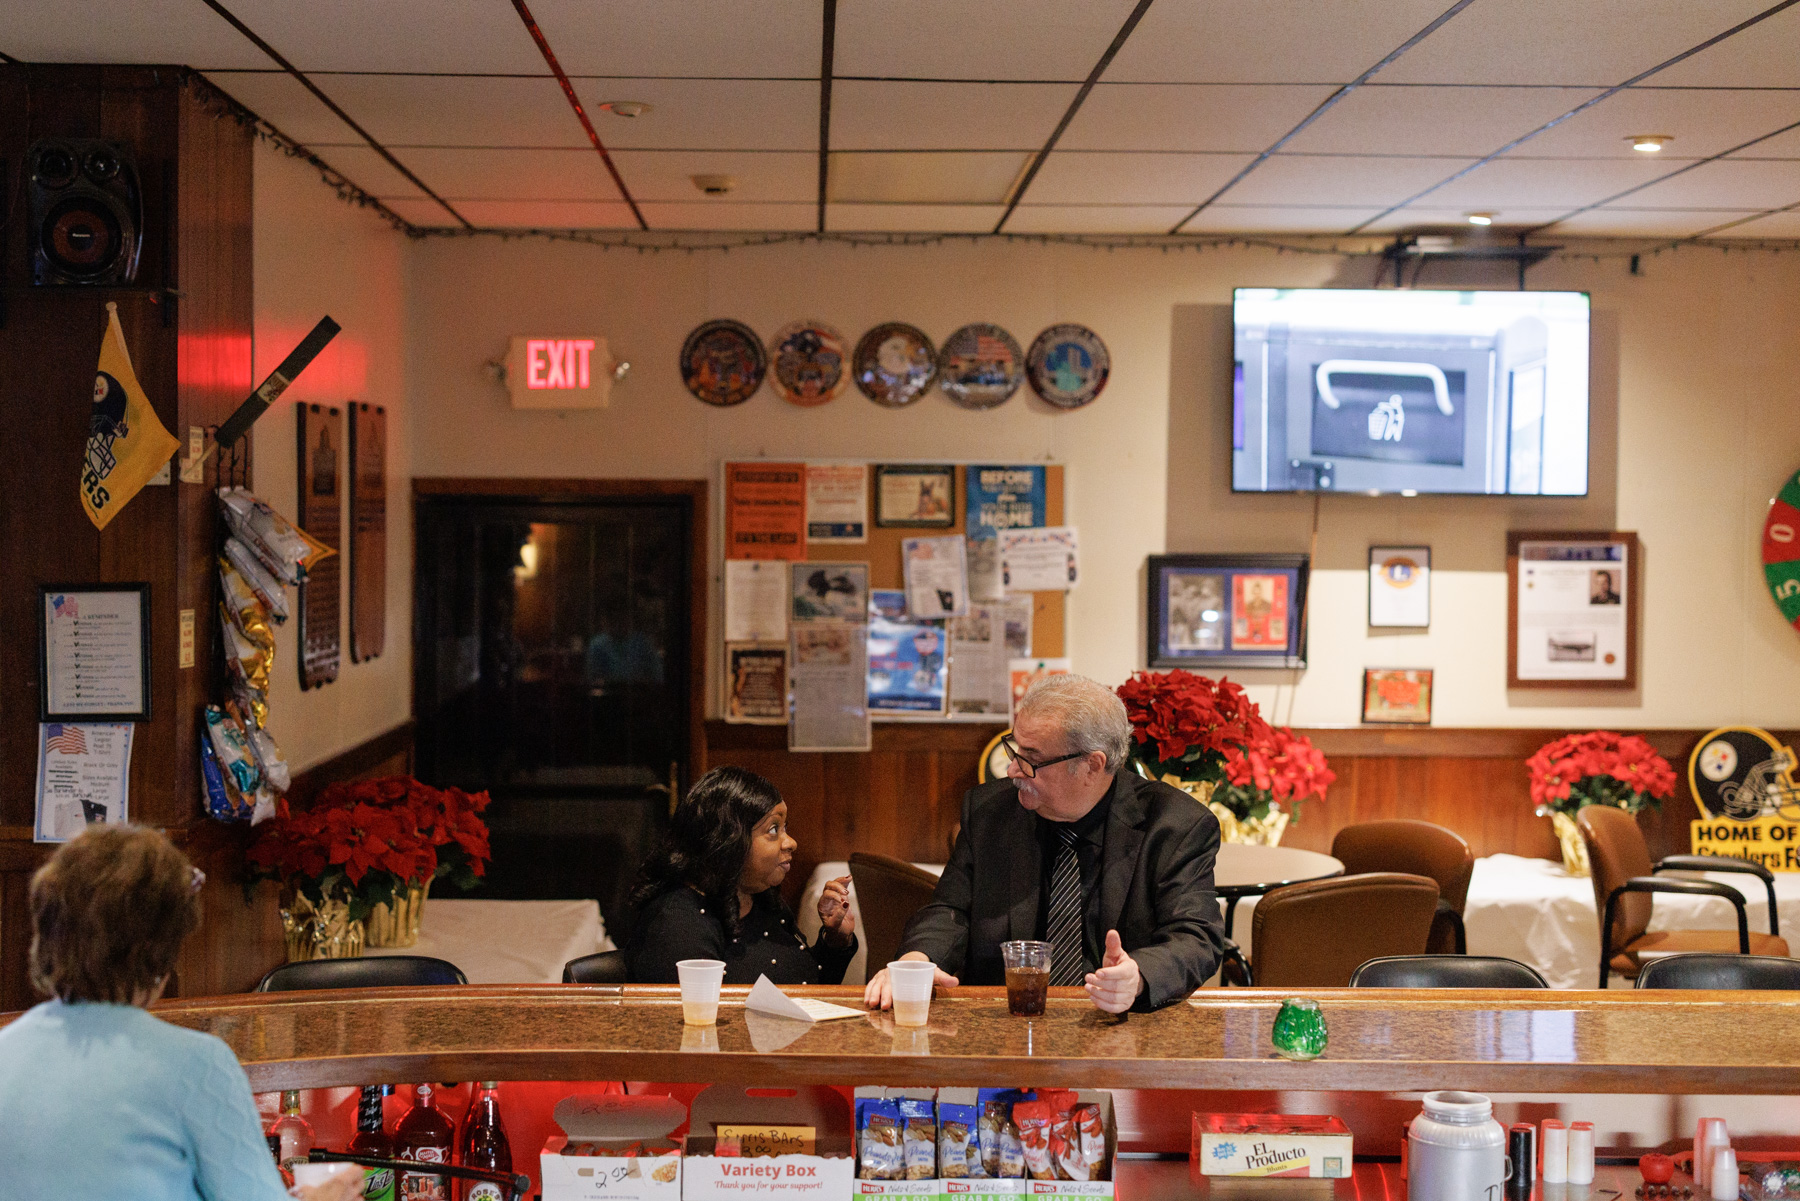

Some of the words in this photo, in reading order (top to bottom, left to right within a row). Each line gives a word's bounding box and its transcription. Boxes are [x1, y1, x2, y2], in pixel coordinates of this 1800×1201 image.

[526, 339, 596, 390] EXIT
[1698, 825, 1762, 841] HOME
[1769, 825, 1798, 841] OF
[1244, 1147, 1307, 1169] Producto
[721, 1163, 782, 1180] Variety
[786, 1164, 817, 1177] Box
[714, 1180, 740, 1189] Thank
[741, 1182, 756, 1192] you
[756, 1180, 769, 1192] for
[769, 1182, 789, 1192] your
[789, 1180, 823, 1192] support!
[471, 1188, 502, 1201] ROSE'S
